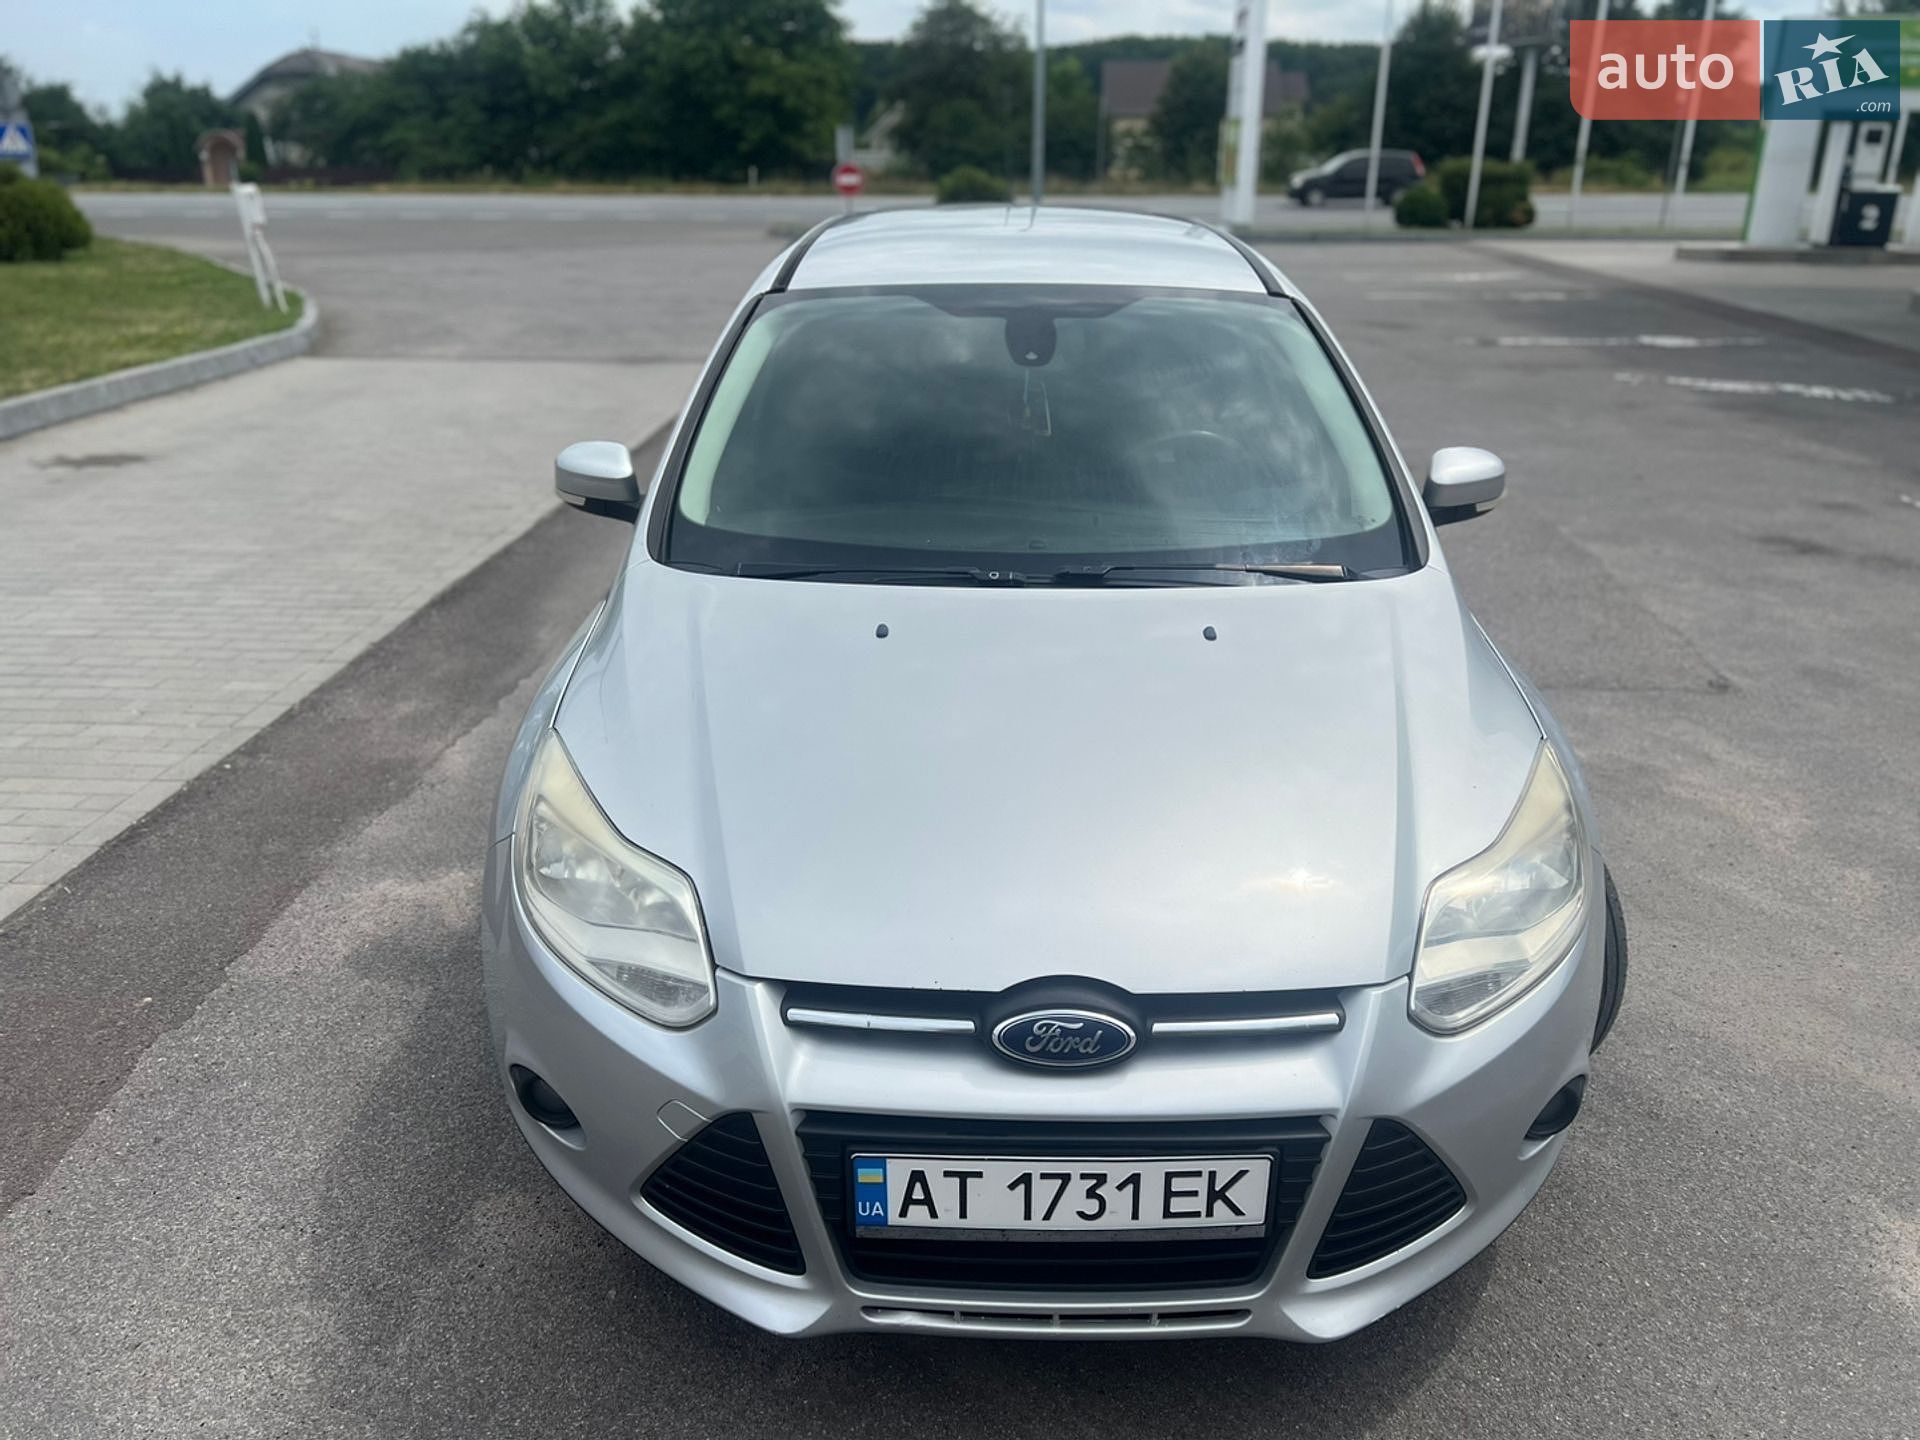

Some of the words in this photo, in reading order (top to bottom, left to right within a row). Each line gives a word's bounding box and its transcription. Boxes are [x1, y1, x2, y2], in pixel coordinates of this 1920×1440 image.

[1025, 1019, 1103, 1054] Ford
[857, 1202, 884, 1216] UA
[898, 1170, 984, 1220] AT
[1007, 1172, 1141, 1221] 1731
[1162, 1169, 1250, 1219] EK
